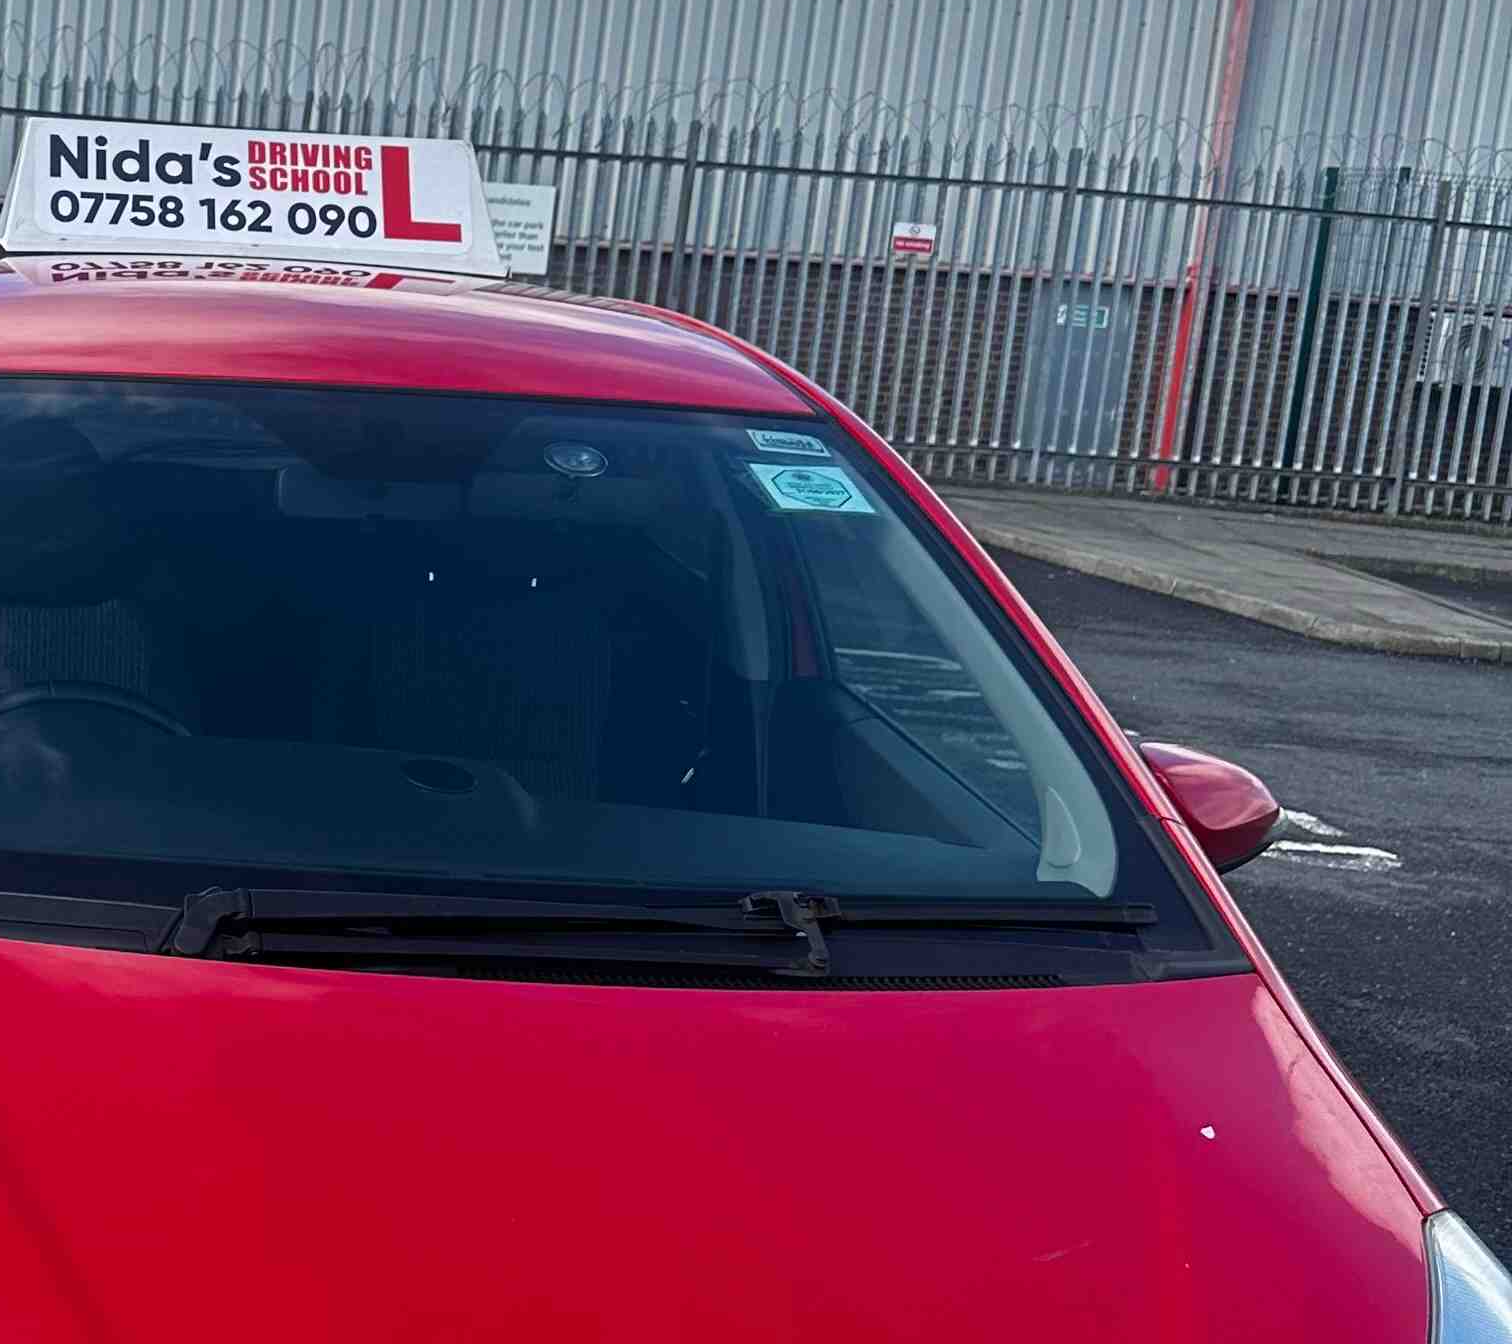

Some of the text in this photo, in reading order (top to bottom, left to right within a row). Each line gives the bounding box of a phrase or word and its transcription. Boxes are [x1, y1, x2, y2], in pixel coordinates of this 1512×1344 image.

[49, 134, 242, 188] Nida's
[248, 140, 373, 171] DRIVING
[249, 167, 369, 196] SCHOOL
[381, 145, 463, 242] L
[50, 190, 377, 239] 07758 162 090
